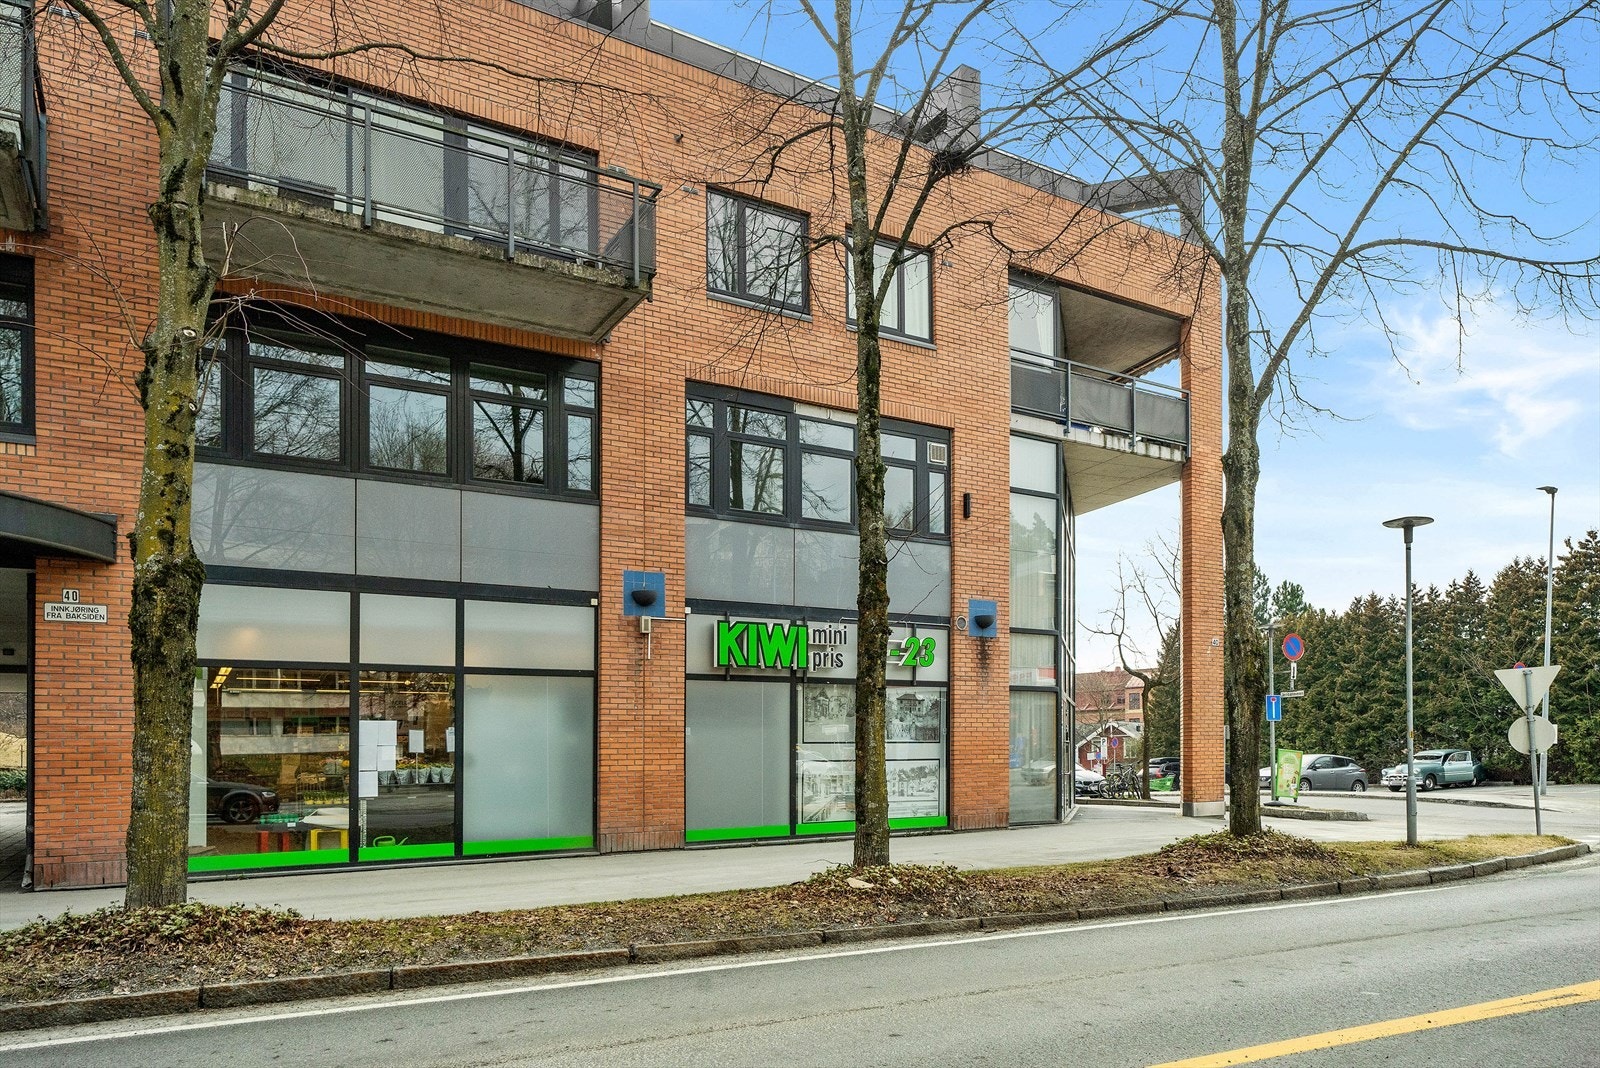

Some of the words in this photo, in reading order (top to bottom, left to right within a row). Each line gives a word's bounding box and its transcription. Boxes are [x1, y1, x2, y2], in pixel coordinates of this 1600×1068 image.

[64, 591, 78, 601] 40
[51, 605, 99, 613] INNKJØRING
[716, 619, 808, 669] KIWI
[812, 624, 847, 645] mini
[812, 647, 844, 671] pris
[889, 636, 936, 667] -23
